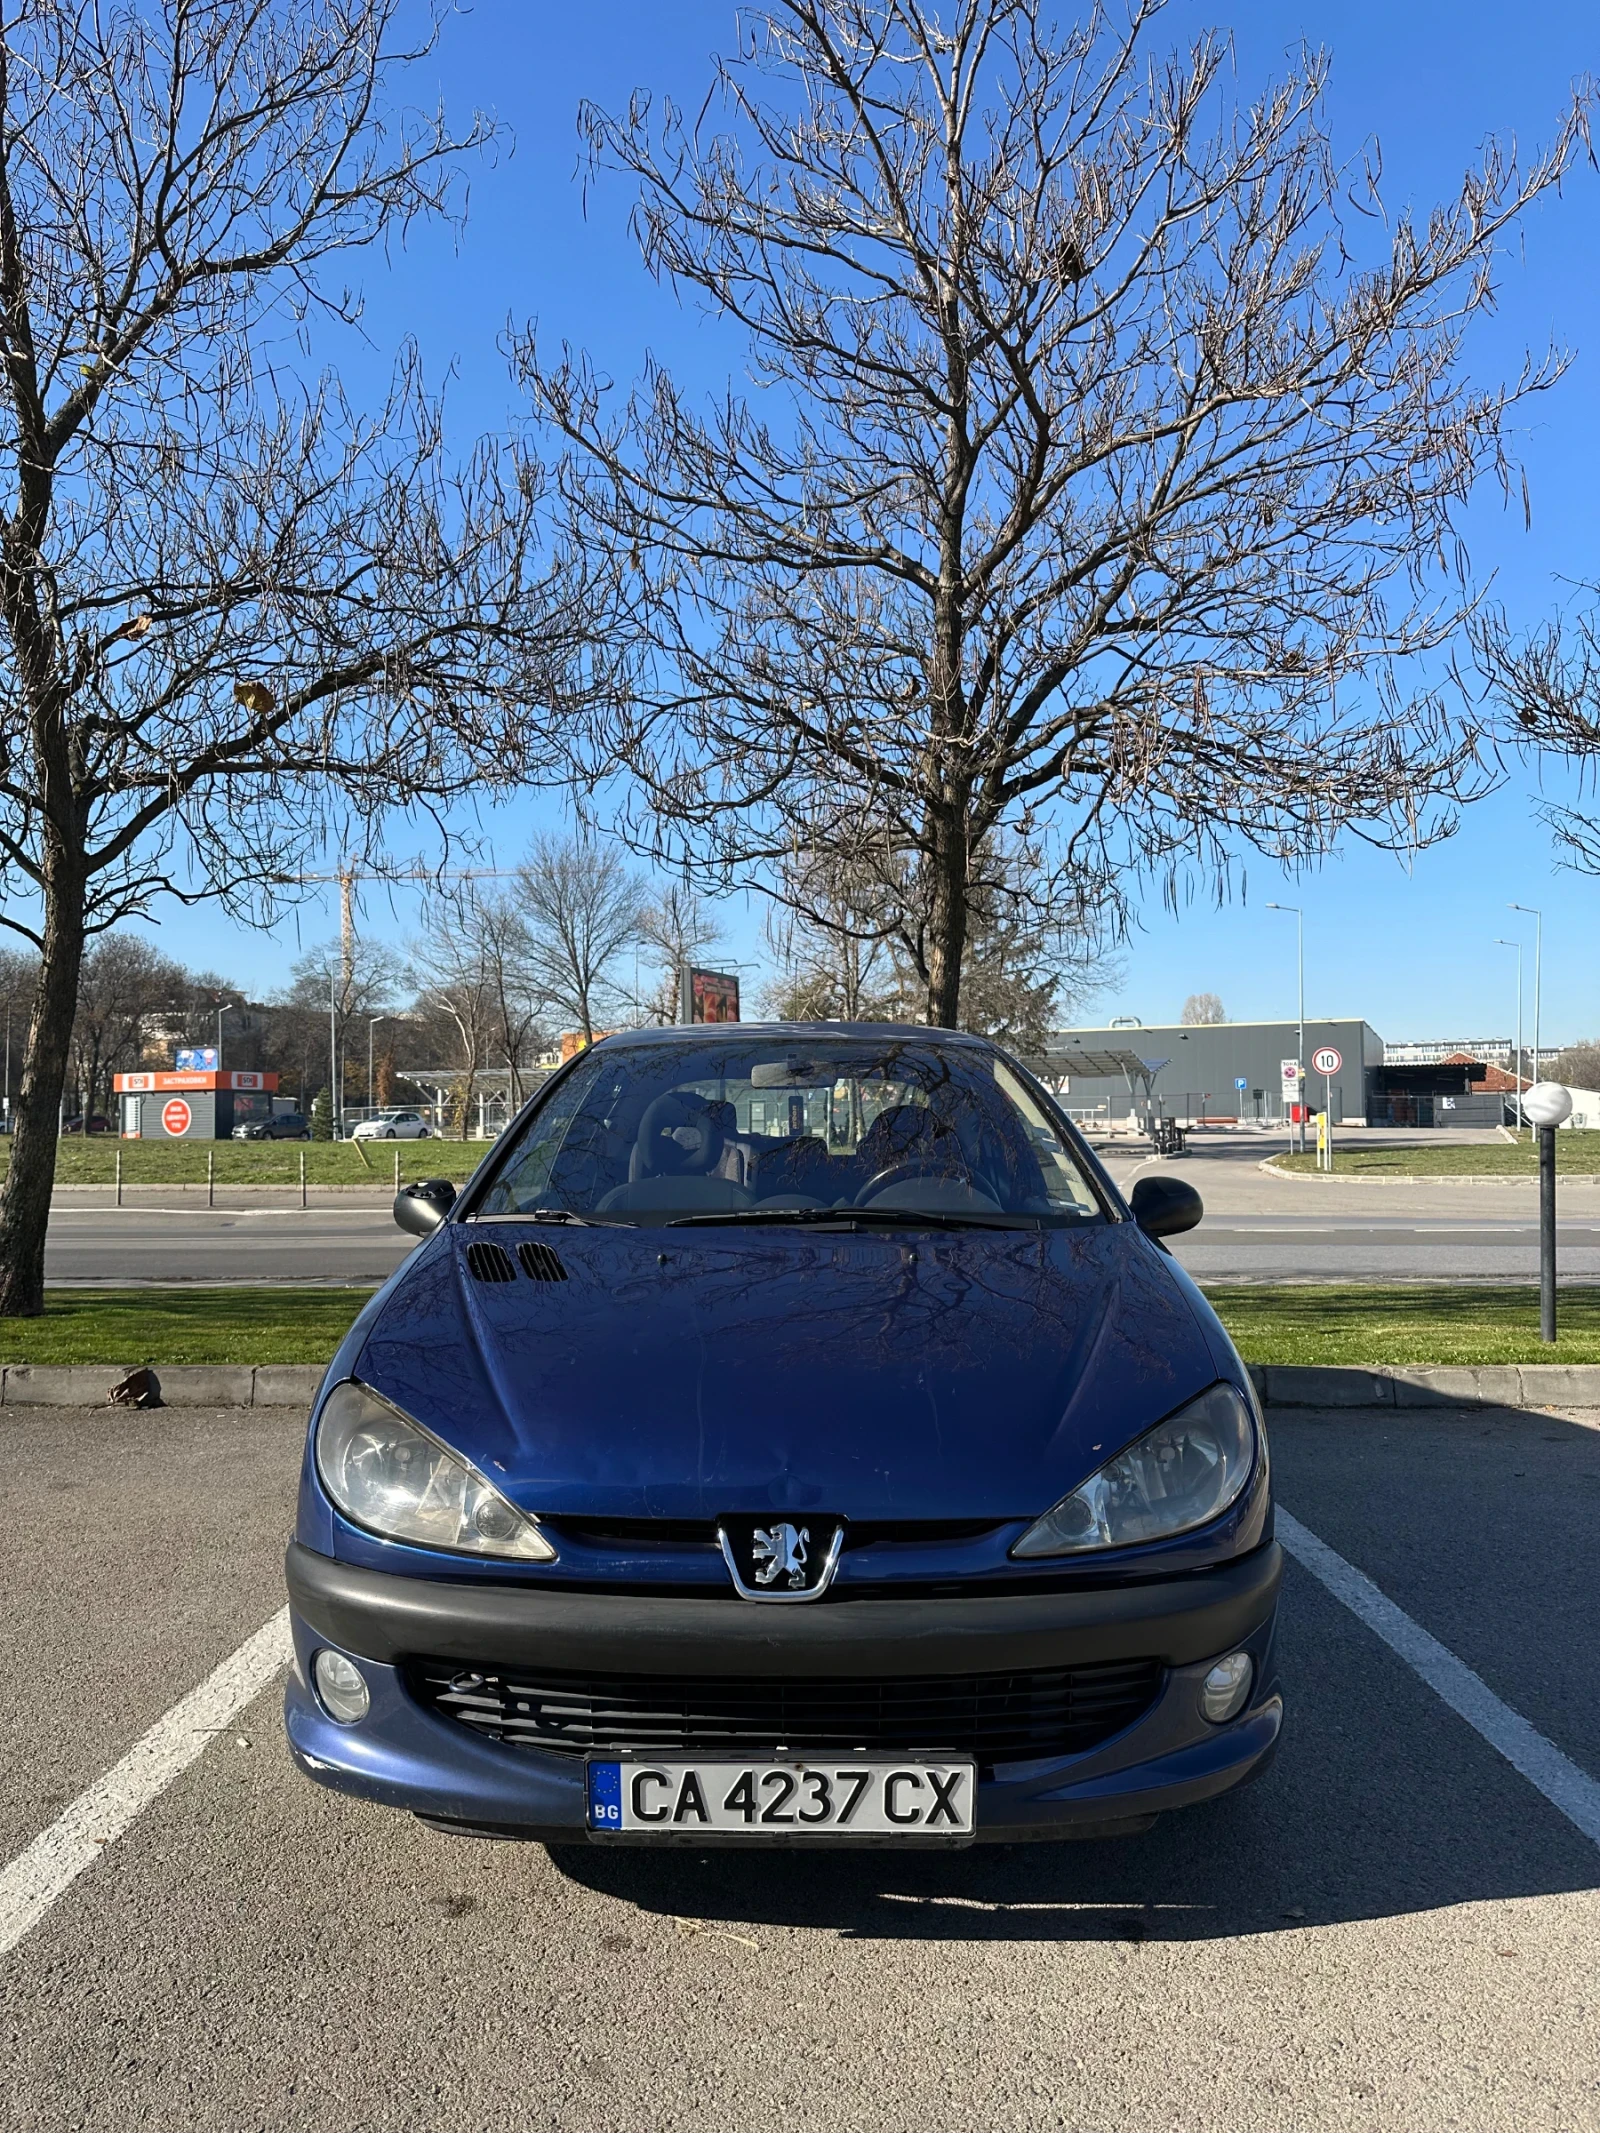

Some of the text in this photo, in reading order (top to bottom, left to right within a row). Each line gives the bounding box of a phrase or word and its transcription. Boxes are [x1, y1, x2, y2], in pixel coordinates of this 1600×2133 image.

[1321, 1055, 1334, 1068] 10
[163, 1076, 207, 1085] ЗАСТРАХОВКИ
[631, 1770, 962, 1824] CA 4237 CX
[594, 1805, 619, 1820] BG
